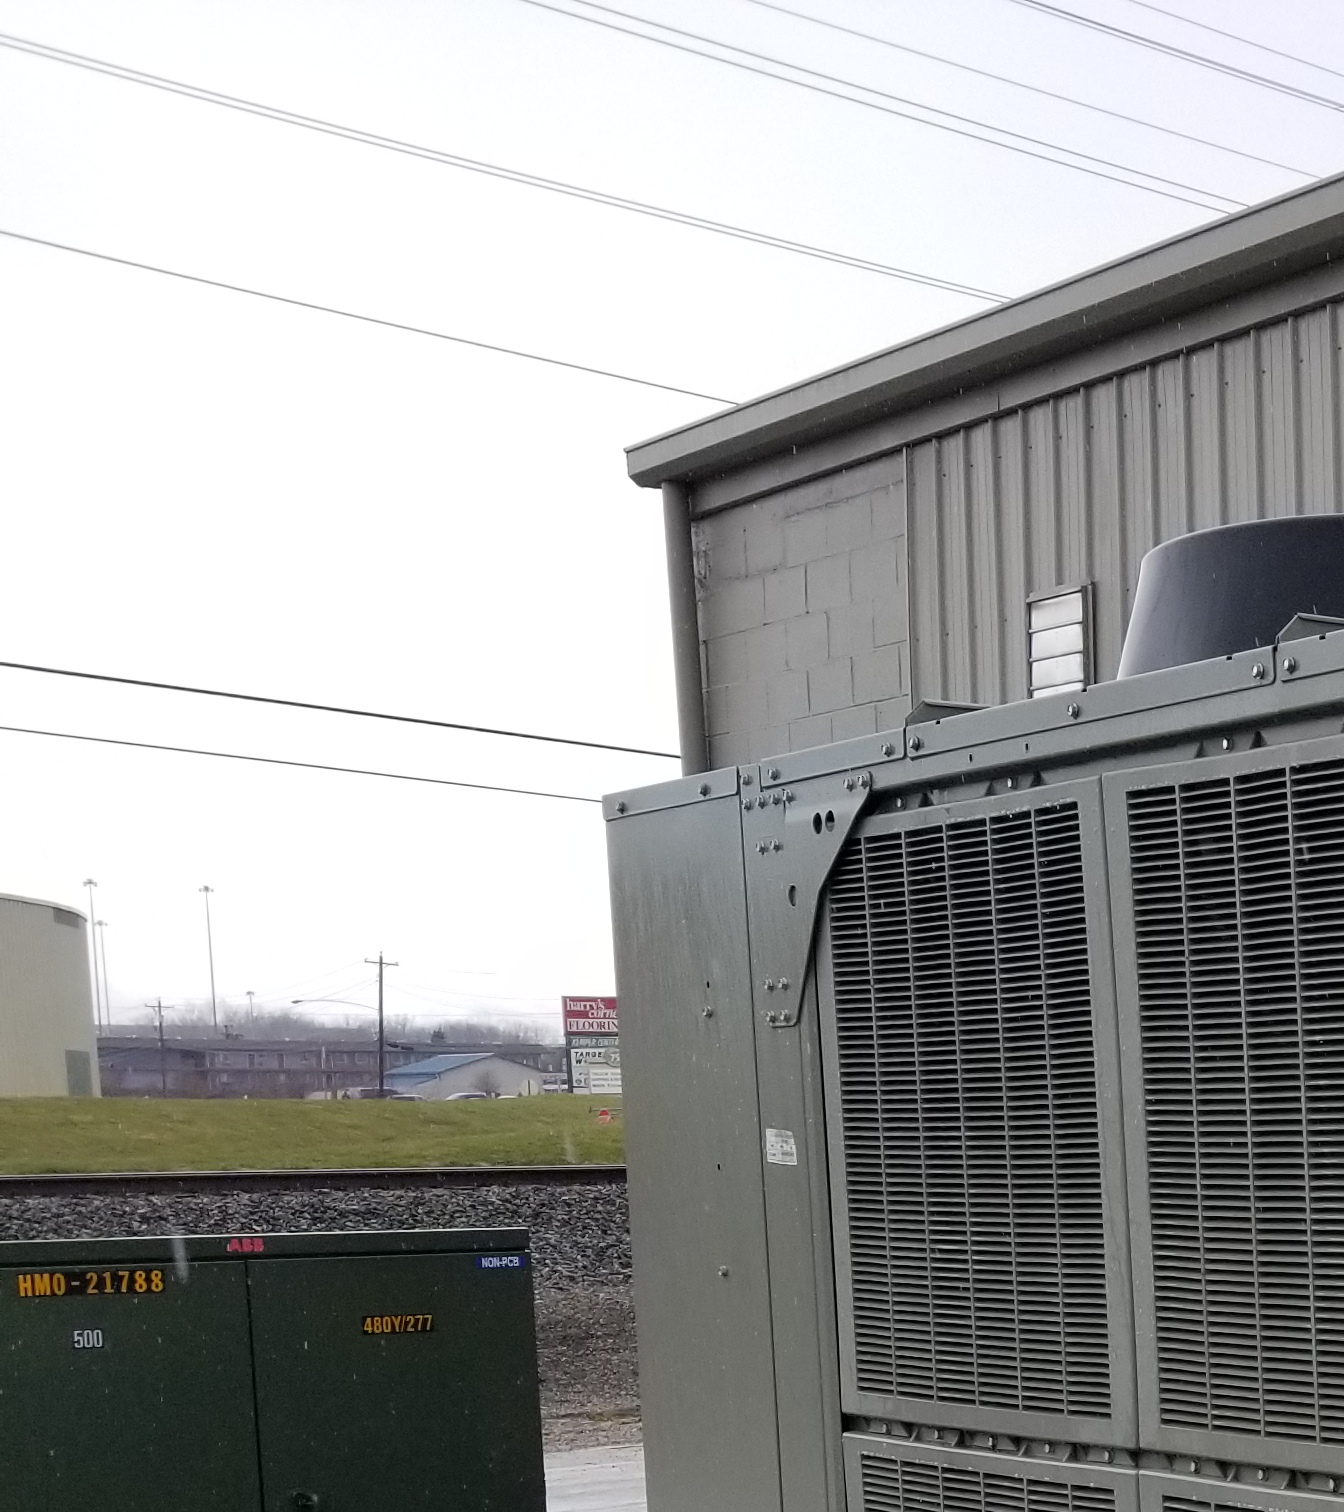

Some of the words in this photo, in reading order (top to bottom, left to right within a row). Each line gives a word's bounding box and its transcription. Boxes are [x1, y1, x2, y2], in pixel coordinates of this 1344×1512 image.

[566, 998, 605, 1010] harry's
[227, 1238, 264, 1253] ABB
[481, 1256, 520, 1268] NON-PCB
[363, 1314, 433, 1334] 480Y/277
[73, 1330, 103, 1348] 500
